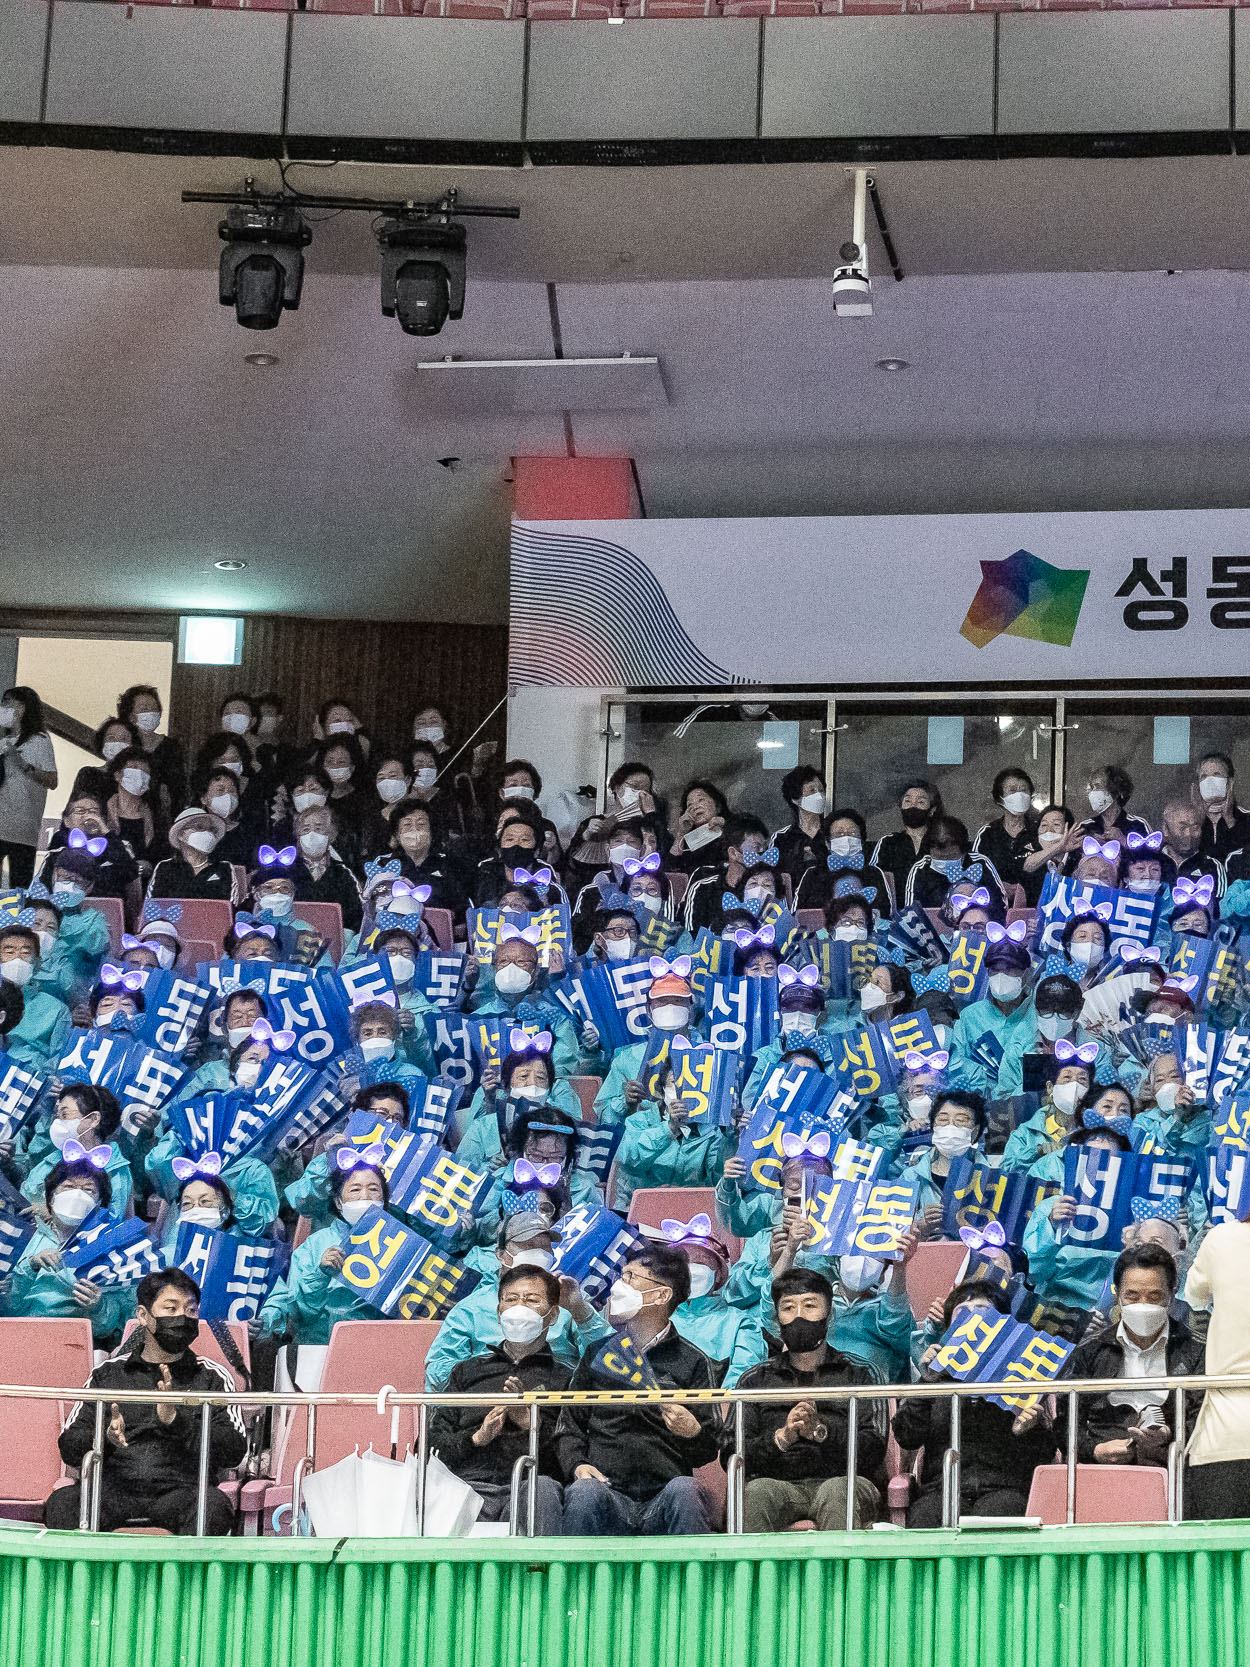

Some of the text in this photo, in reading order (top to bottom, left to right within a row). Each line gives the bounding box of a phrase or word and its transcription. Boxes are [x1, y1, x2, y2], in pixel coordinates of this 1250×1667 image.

[1042, 882, 1155, 958] 성동
[555, 960, 654, 1036] 성동
[949, 937, 987, 993] 성
[839, 1018, 934, 1096] 성동
[351, 1123, 482, 1227] 성동
[806, 1185, 914, 1252] 성동
[178, 1232, 276, 1322] 성동
[341, 1217, 463, 1320] 성동
[940, 1314, 1068, 1410] 성동
